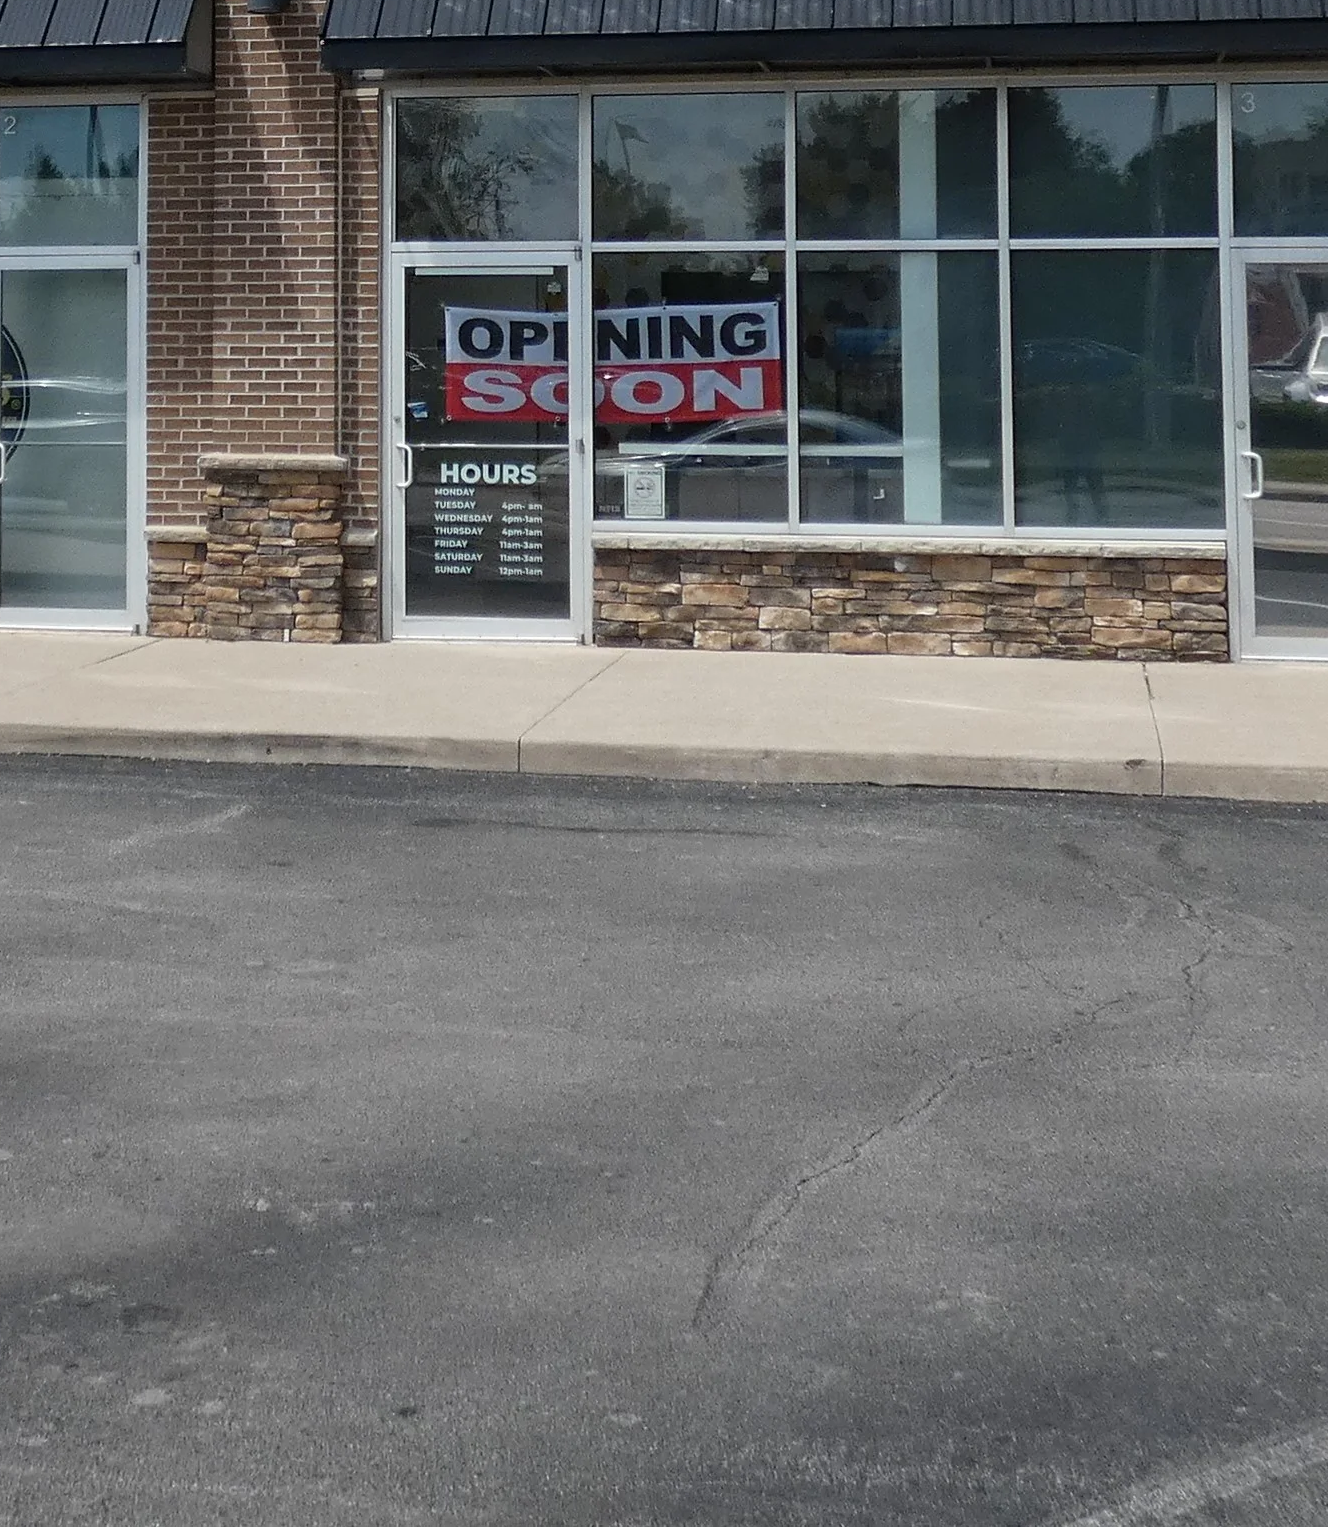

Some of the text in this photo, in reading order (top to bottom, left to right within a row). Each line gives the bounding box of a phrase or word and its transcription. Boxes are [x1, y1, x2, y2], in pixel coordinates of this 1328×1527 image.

[1240, 92, 1256, 113] 3
[4, 115, 16, 135] 2
[441, 463, 537, 485] HOURS
[434, 488, 475, 496] MONDAY
[434, 501, 476, 509] TUESDAY
[434, 514, 543, 524] WEDNESDAY 4pm-1am
[434, 527, 543, 537] THURSDAY 4pm-1am
[434, 540, 543, 550] FRIDAY 11am-3am
[434, 553, 543, 563] SATURDAY 11am-3am
[434, 566, 543, 576] SUNDAY 12pm-1am
